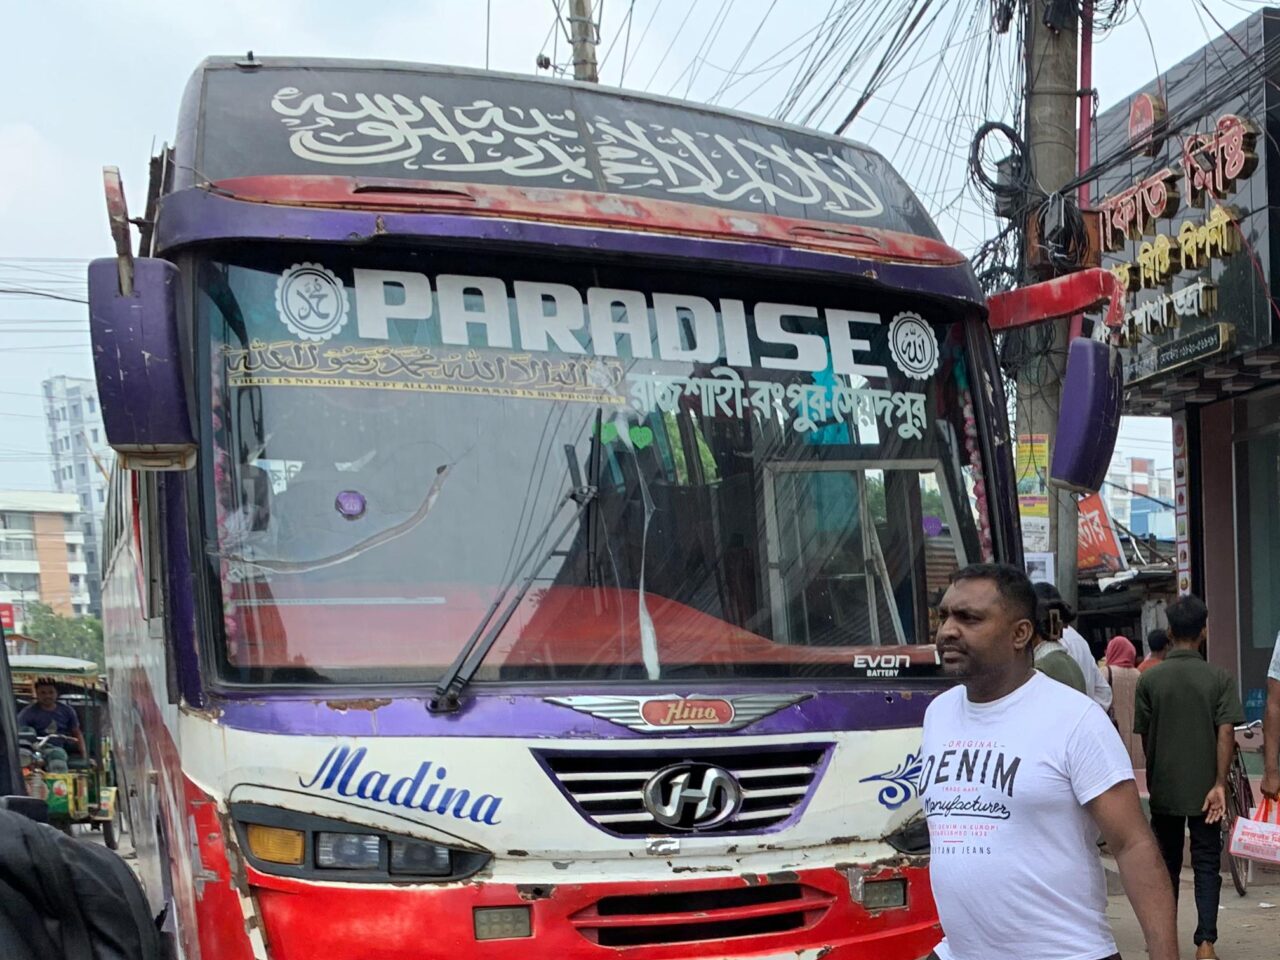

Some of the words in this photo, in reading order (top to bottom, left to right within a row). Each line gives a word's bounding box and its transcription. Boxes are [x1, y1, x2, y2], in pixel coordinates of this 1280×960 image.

[353, 268, 888, 378] PARADISE
[867, 669, 899, 677] BATTERY
[660, 700, 720, 725] Hino
[299, 744, 503, 825] Madina
[919, 749, 1021, 797] DENIM
[961, 846, 991, 855] JEANS
